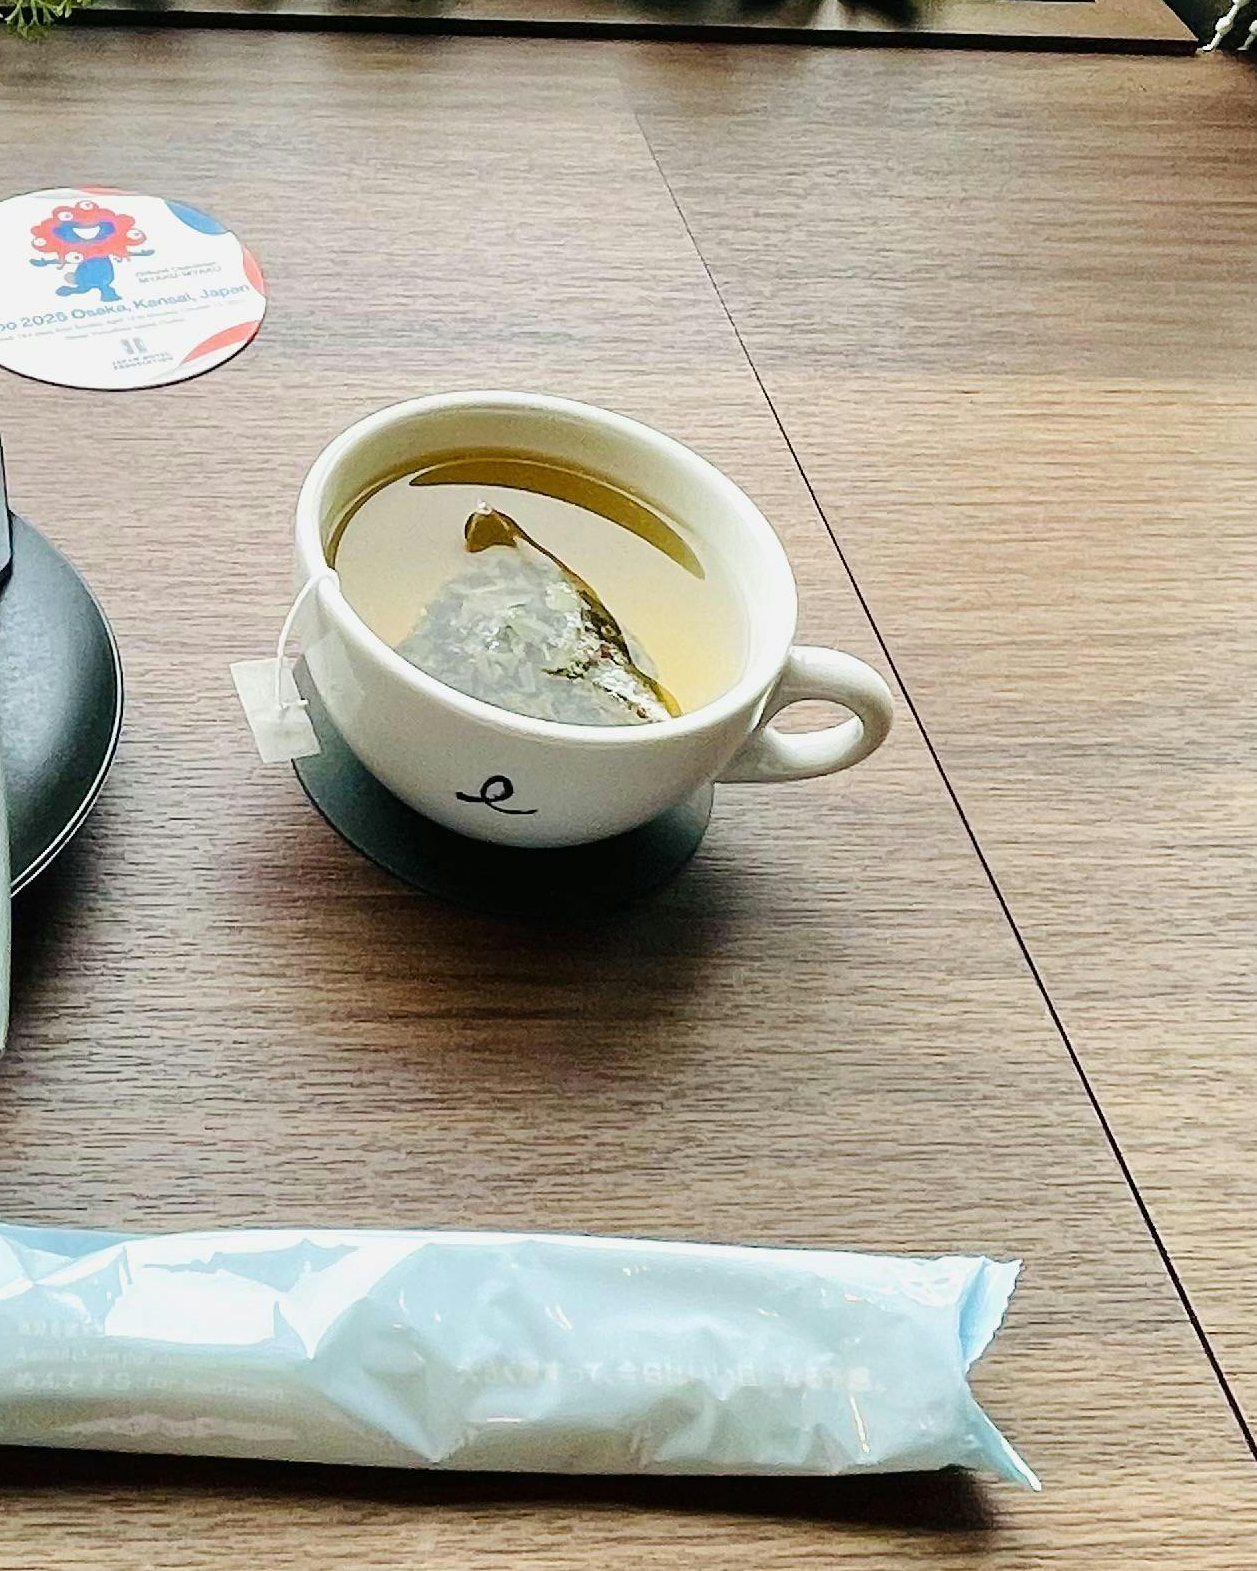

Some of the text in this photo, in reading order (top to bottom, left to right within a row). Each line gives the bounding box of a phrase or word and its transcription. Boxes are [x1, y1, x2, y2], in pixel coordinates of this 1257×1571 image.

[20, 311, 68, 328] 2025
[71, 305, 131, 320] Osaka,
[133, 292, 196, 309] Kansai,
[200, 284, 250, 299] Japan
